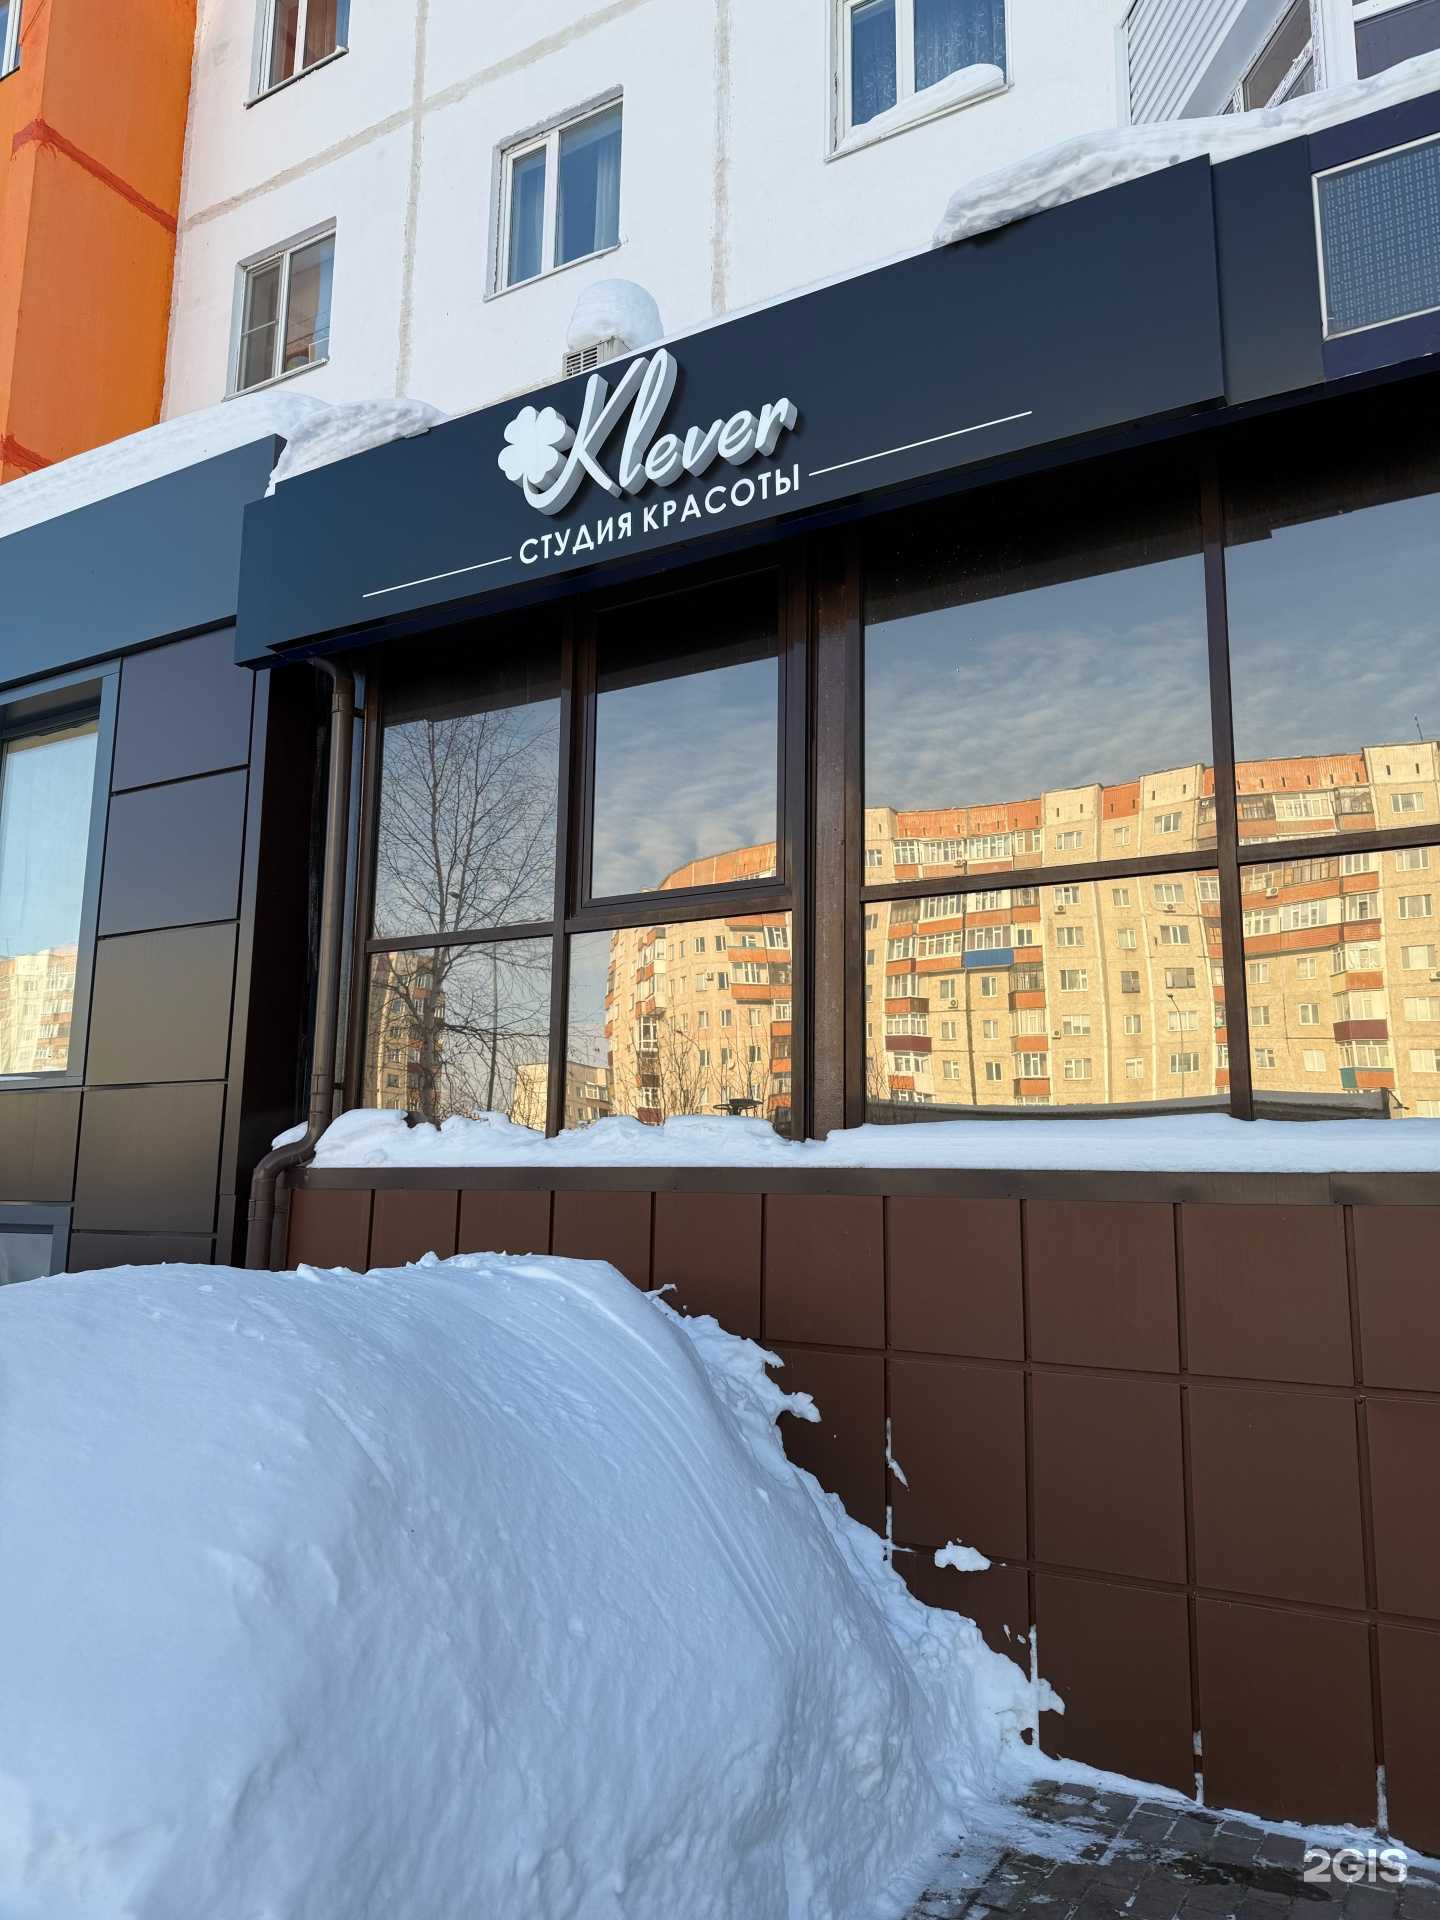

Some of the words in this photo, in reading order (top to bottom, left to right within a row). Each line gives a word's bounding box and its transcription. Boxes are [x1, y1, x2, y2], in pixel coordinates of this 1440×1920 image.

[523, 348, 798, 516] Klever
[519, 512, 632, 564] СТУДИЯ
[642, 464, 799, 532] КРАСОТЫ
